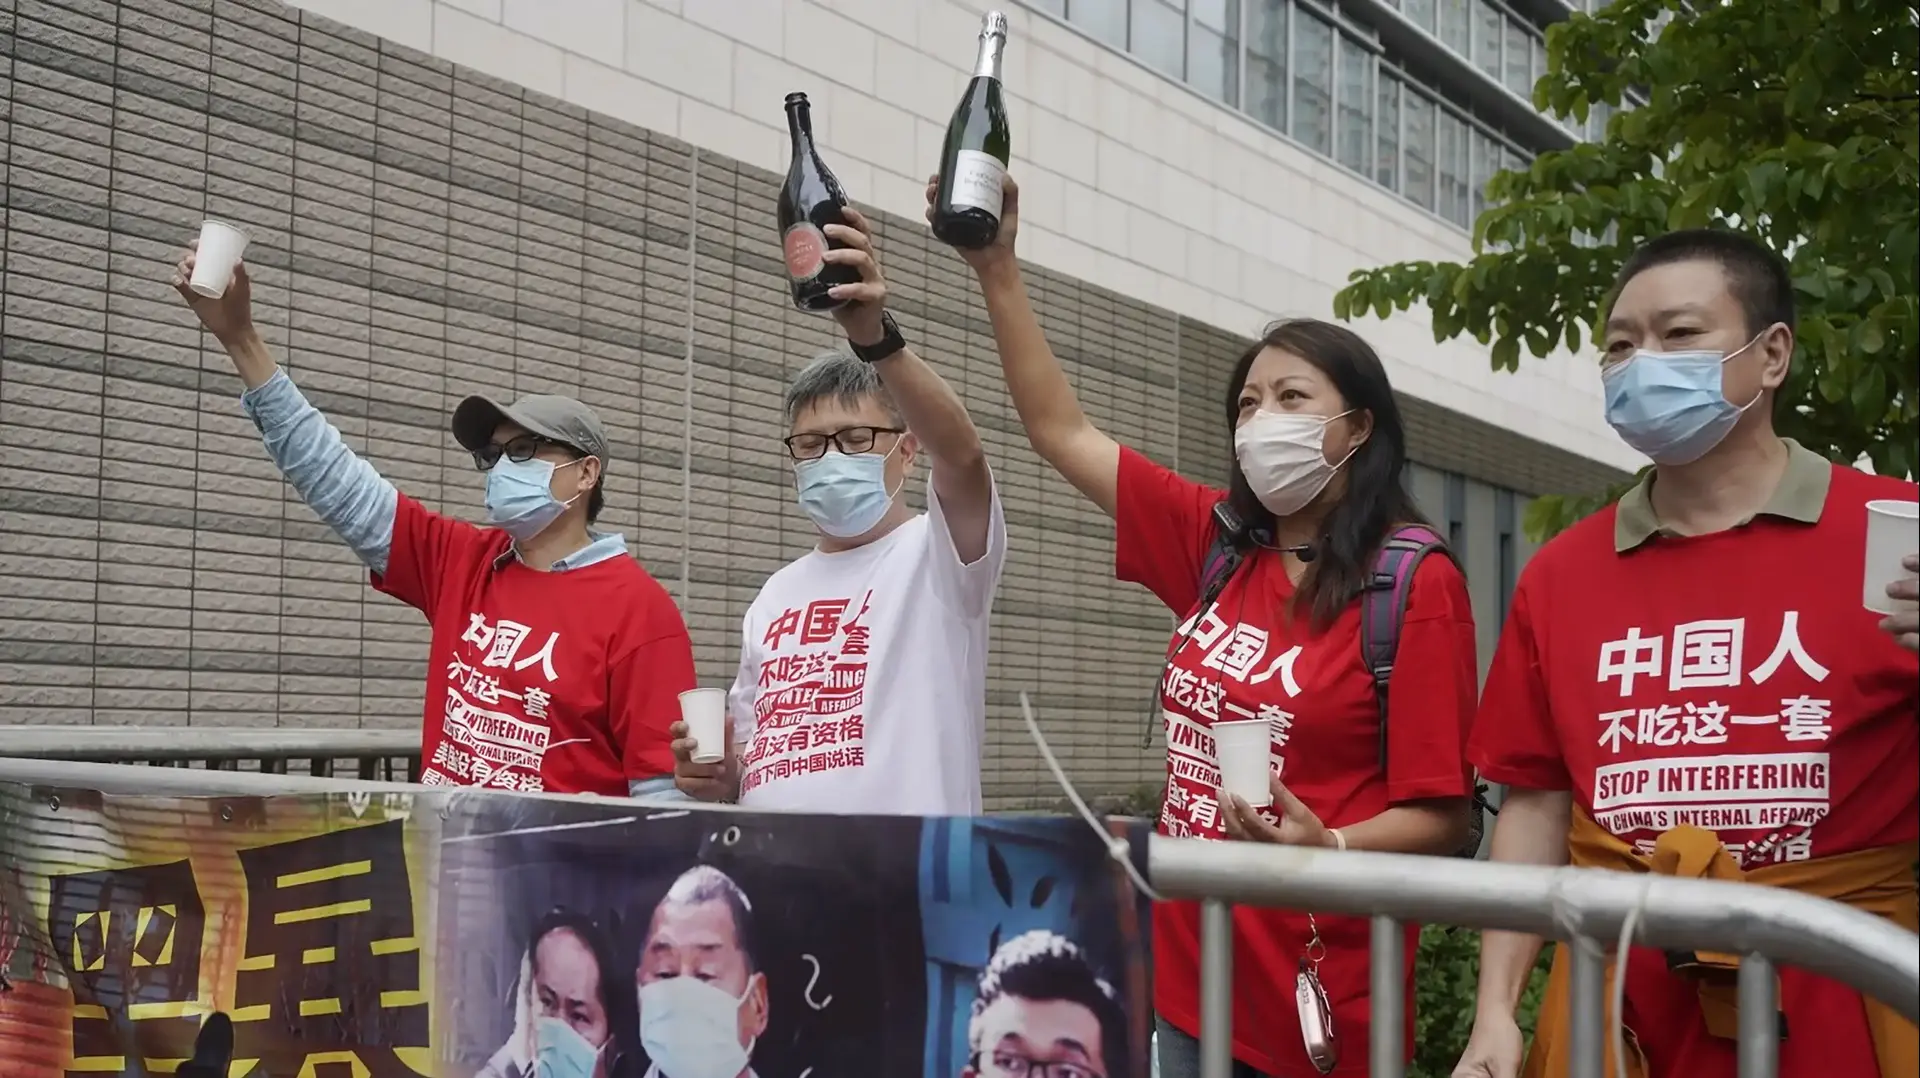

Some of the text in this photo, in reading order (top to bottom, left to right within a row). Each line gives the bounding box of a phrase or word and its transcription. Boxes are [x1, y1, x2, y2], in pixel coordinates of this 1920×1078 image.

[461, 612, 560, 682] 中国人
[1177, 602, 1303, 698] 中国人
[1597, 611, 1831, 697] 中国人
[820, 693, 862, 713] AFFAIRS
[1162, 662, 1295, 747] 吃这一套
[1597, 694, 1833, 753] 不吃这一套
[743, 714, 864, 768] 国没有资格
[1176, 759, 1222, 788] INTERNA
[1598, 762, 1826, 801] STOP INTERFERING
[1613, 810, 1668, 831] CHINA'S
[1673, 809, 1753, 828] INTERNAL
[1758, 807, 1826, 825] AFFAIRS
